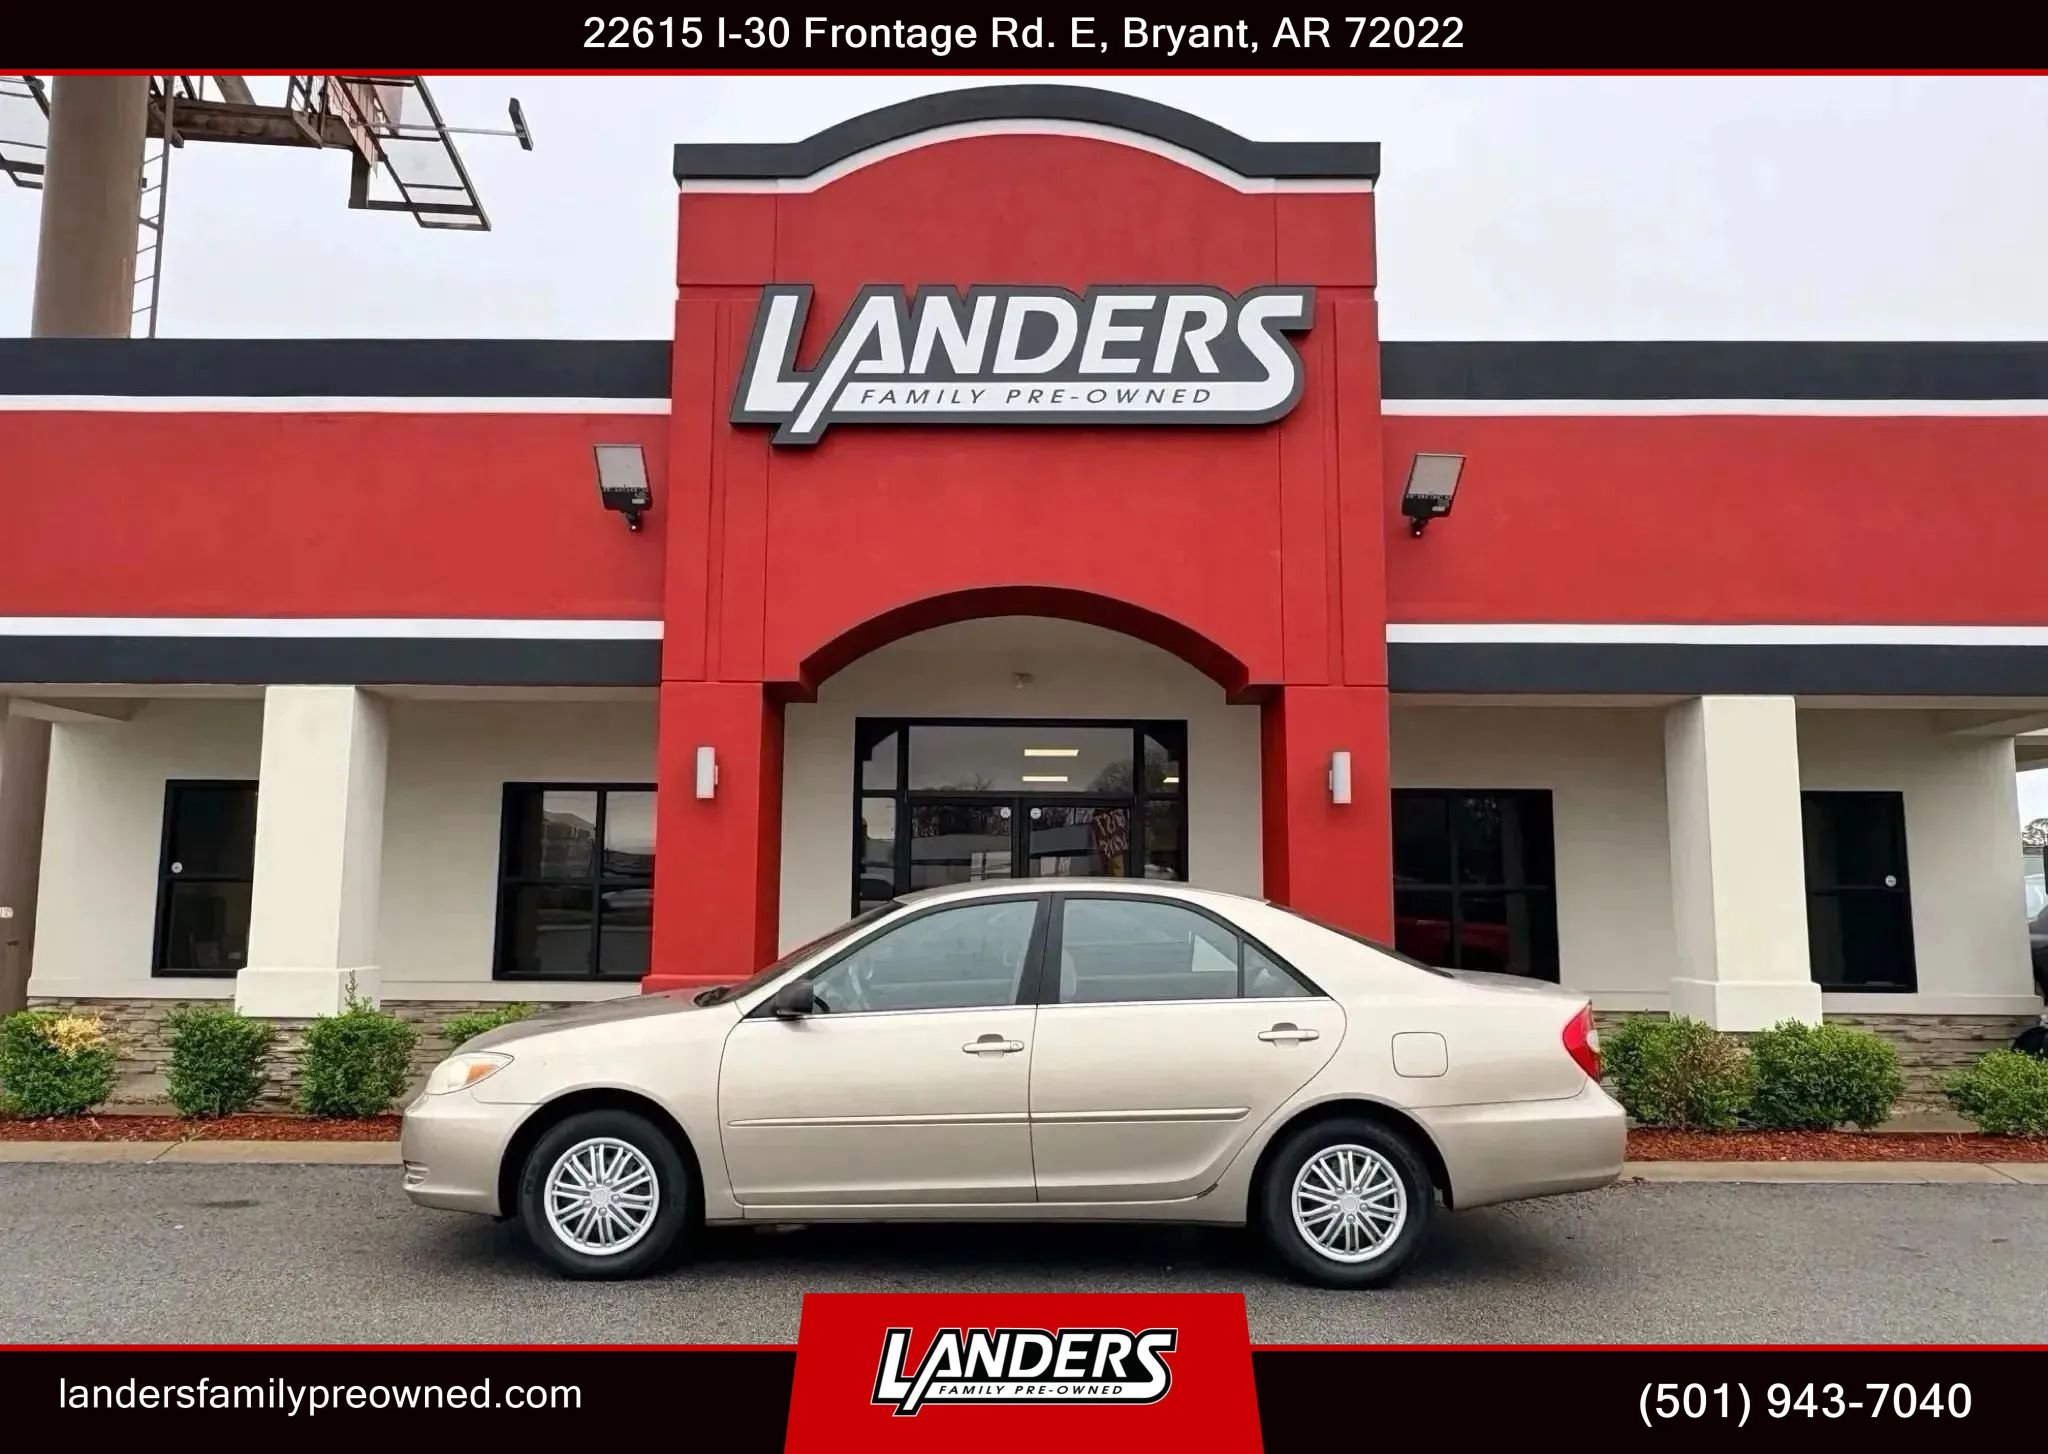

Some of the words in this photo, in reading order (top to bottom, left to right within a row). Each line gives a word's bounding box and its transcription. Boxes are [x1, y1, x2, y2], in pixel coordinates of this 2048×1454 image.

[744, 295, 1304, 432] LANDERS
[860, 388, 986, 404] FAMILY
[1005, 388, 1212, 404] PRE-OWNED
